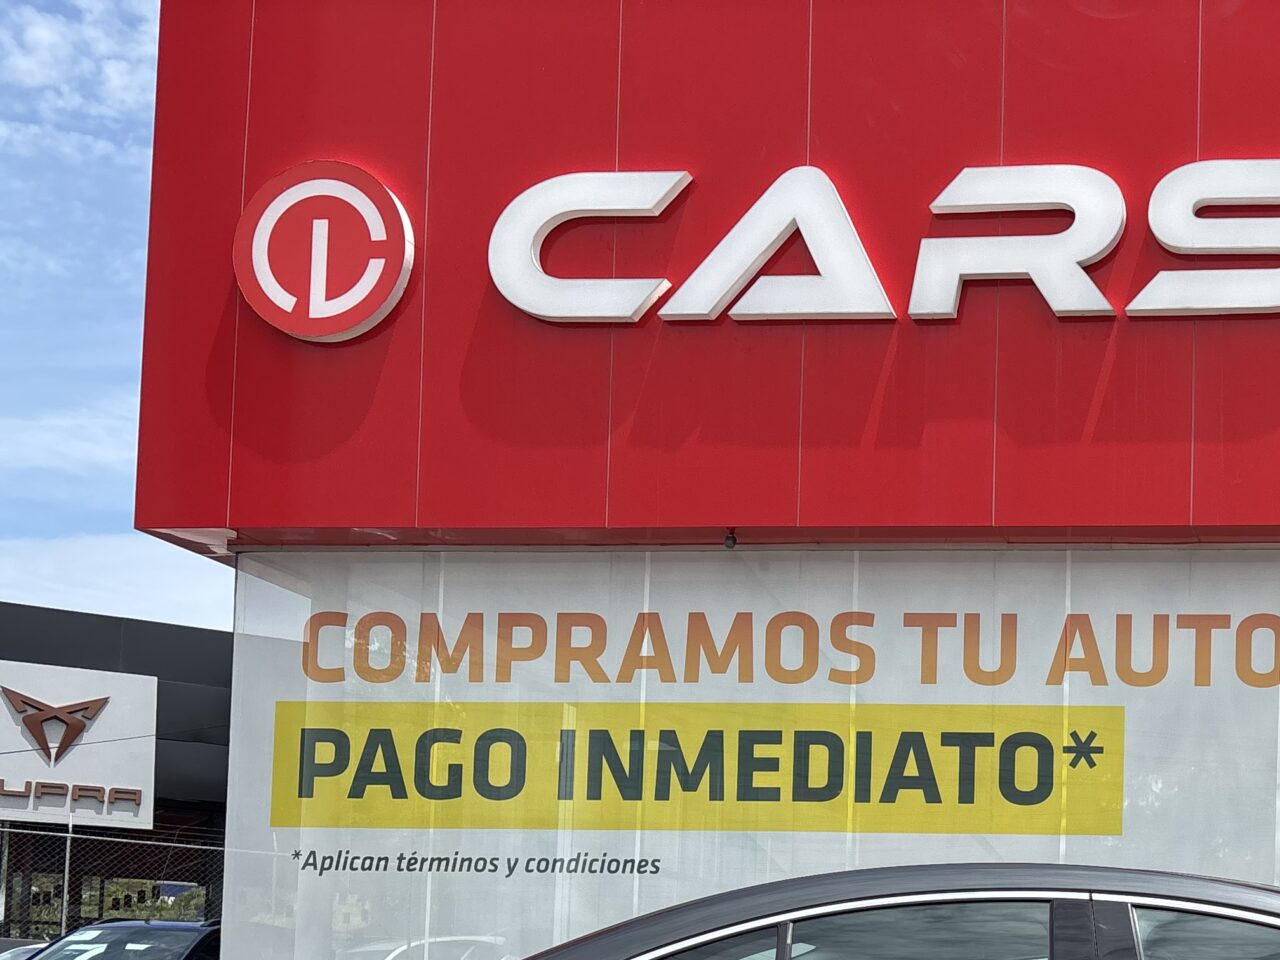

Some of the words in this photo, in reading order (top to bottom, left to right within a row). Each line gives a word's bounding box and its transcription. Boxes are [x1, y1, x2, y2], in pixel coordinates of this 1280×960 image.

[302, 611, 876, 685] COMPRAMOS
[903, 612, 1018, 686] TU
[297, 728, 528, 800] PAGO
[396, 850, 500, 873] términos
[505, 855, 519, 878] y
[524, 852, 662, 875] condiciones
